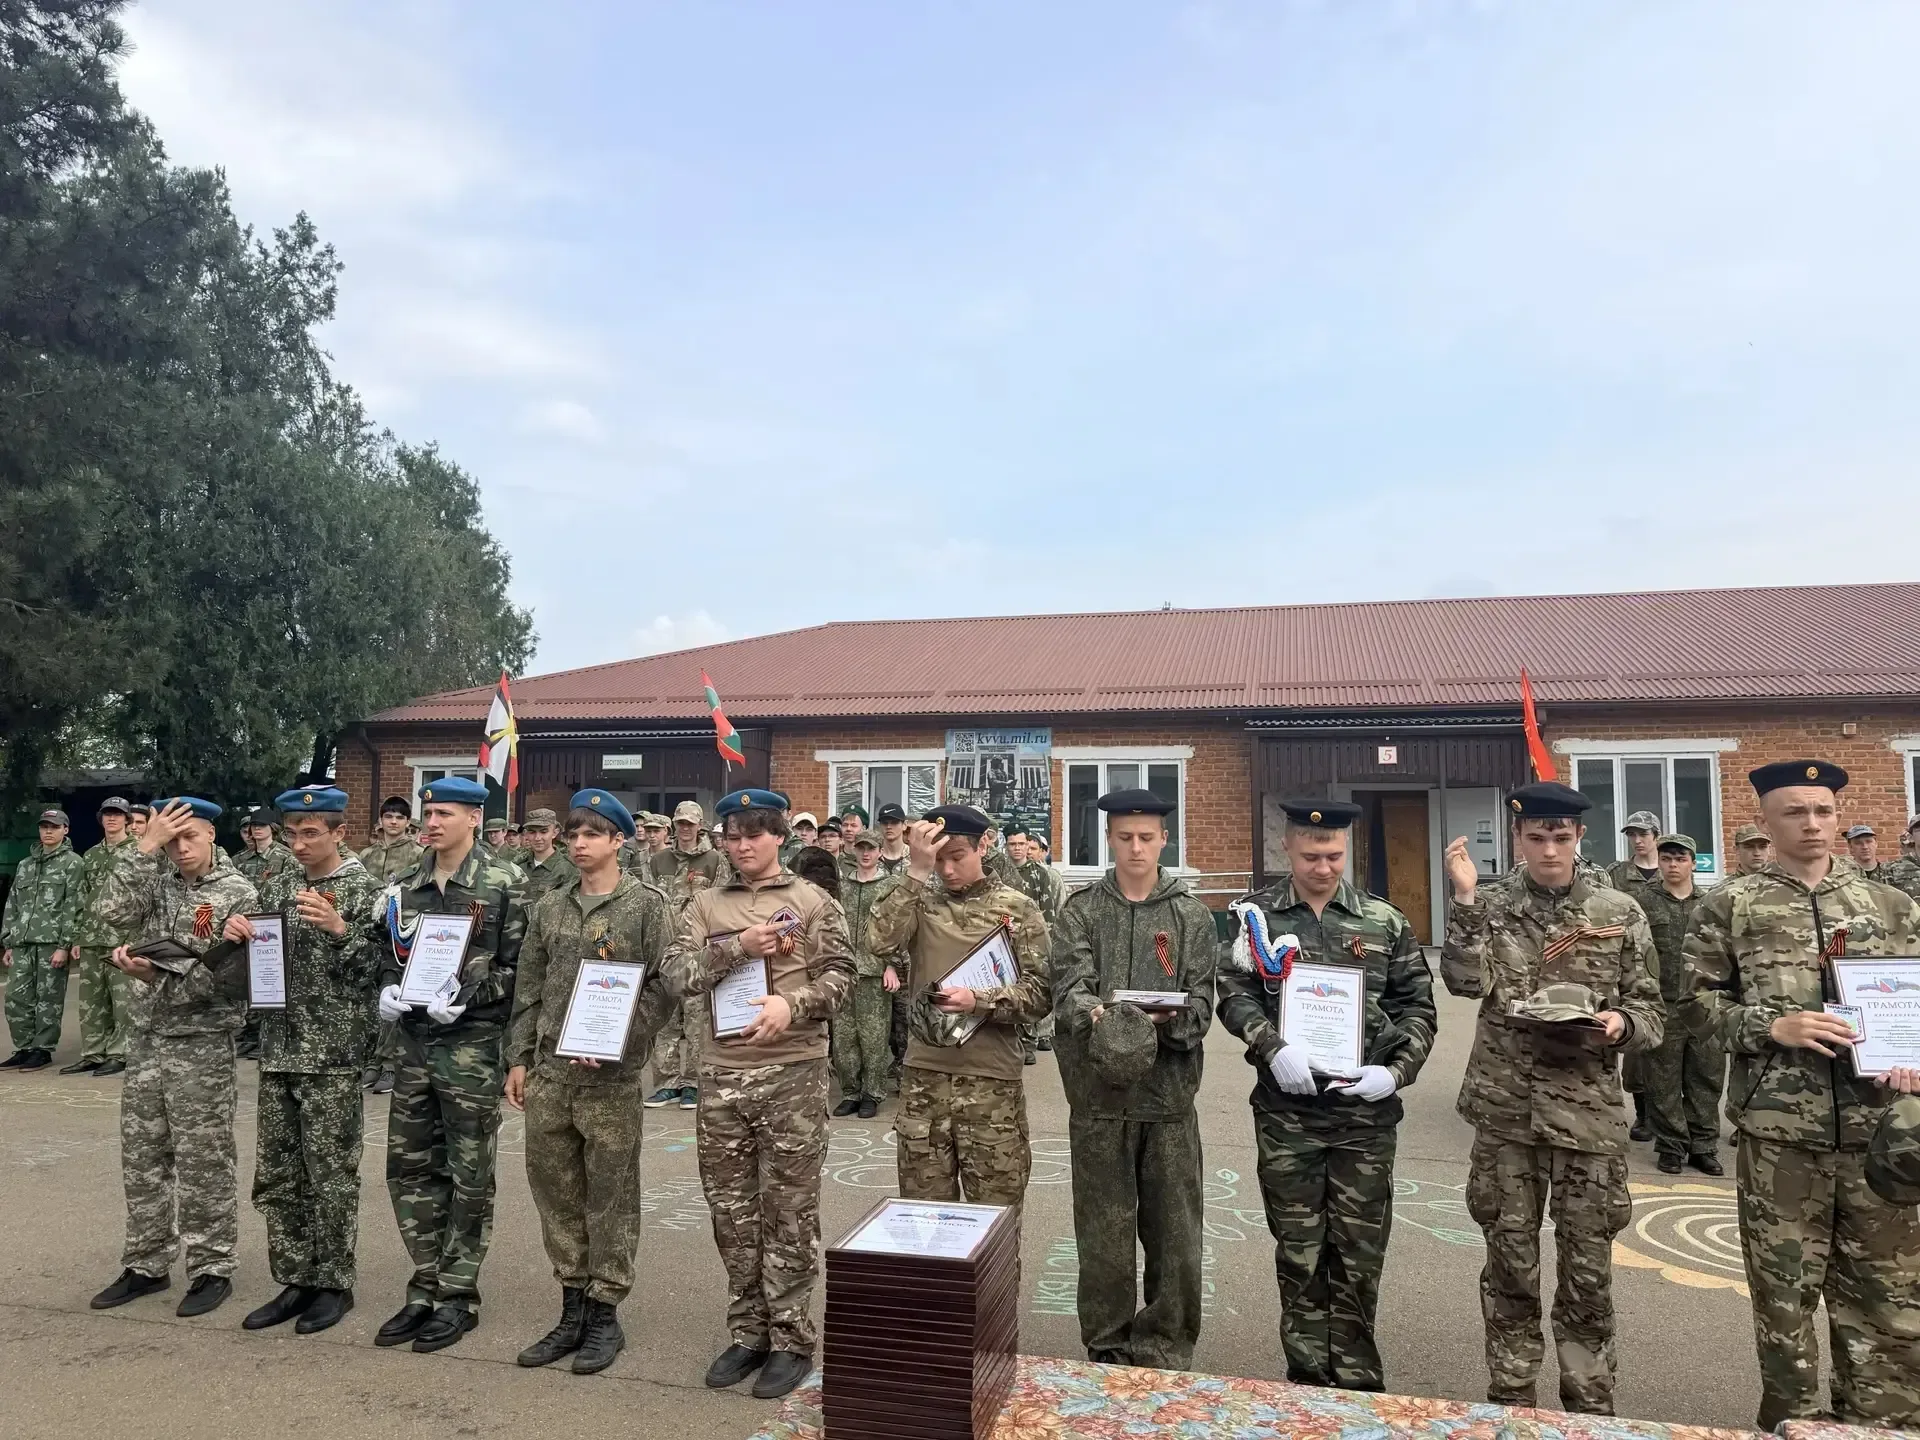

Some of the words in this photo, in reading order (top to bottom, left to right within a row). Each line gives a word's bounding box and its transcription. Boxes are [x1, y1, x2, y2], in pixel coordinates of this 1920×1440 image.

[977, 732, 1047, 744] kvvu.mil.ru
[1383, 749, 1393, 761] 5
[588, 994, 622, 1003] ГРАМОТА
[1301, 1002, 1345, 1014] ГРАМОТА
[1867, 1001, 1920, 1009] ГРАМОТА
